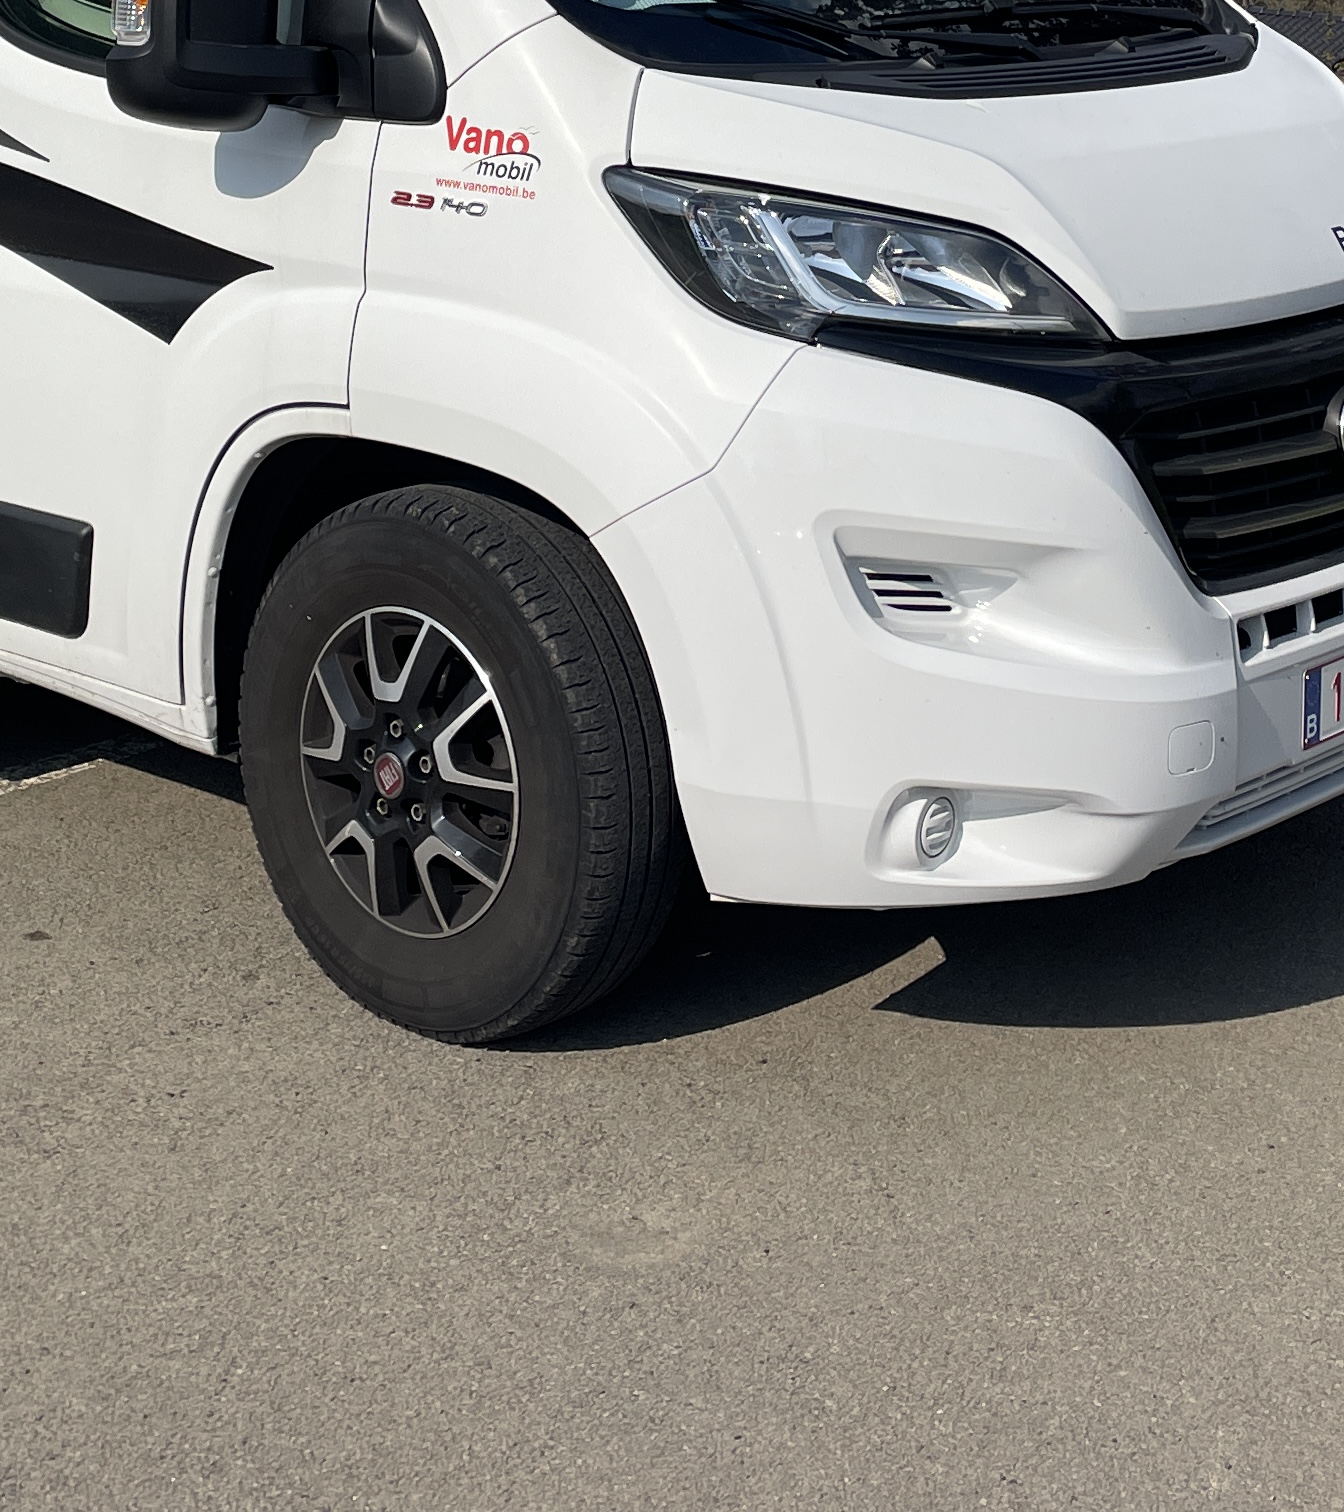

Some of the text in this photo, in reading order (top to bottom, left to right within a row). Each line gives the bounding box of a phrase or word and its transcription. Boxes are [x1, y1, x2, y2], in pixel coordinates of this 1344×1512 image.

[446, 115, 531, 156] Vano
[476, 159, 534, 182] mobil
[390, 190, 435, 210] 2.3
[435, 176, 536, 200] www.vanomobil.be
[1306, 713, 1318, 739] B
